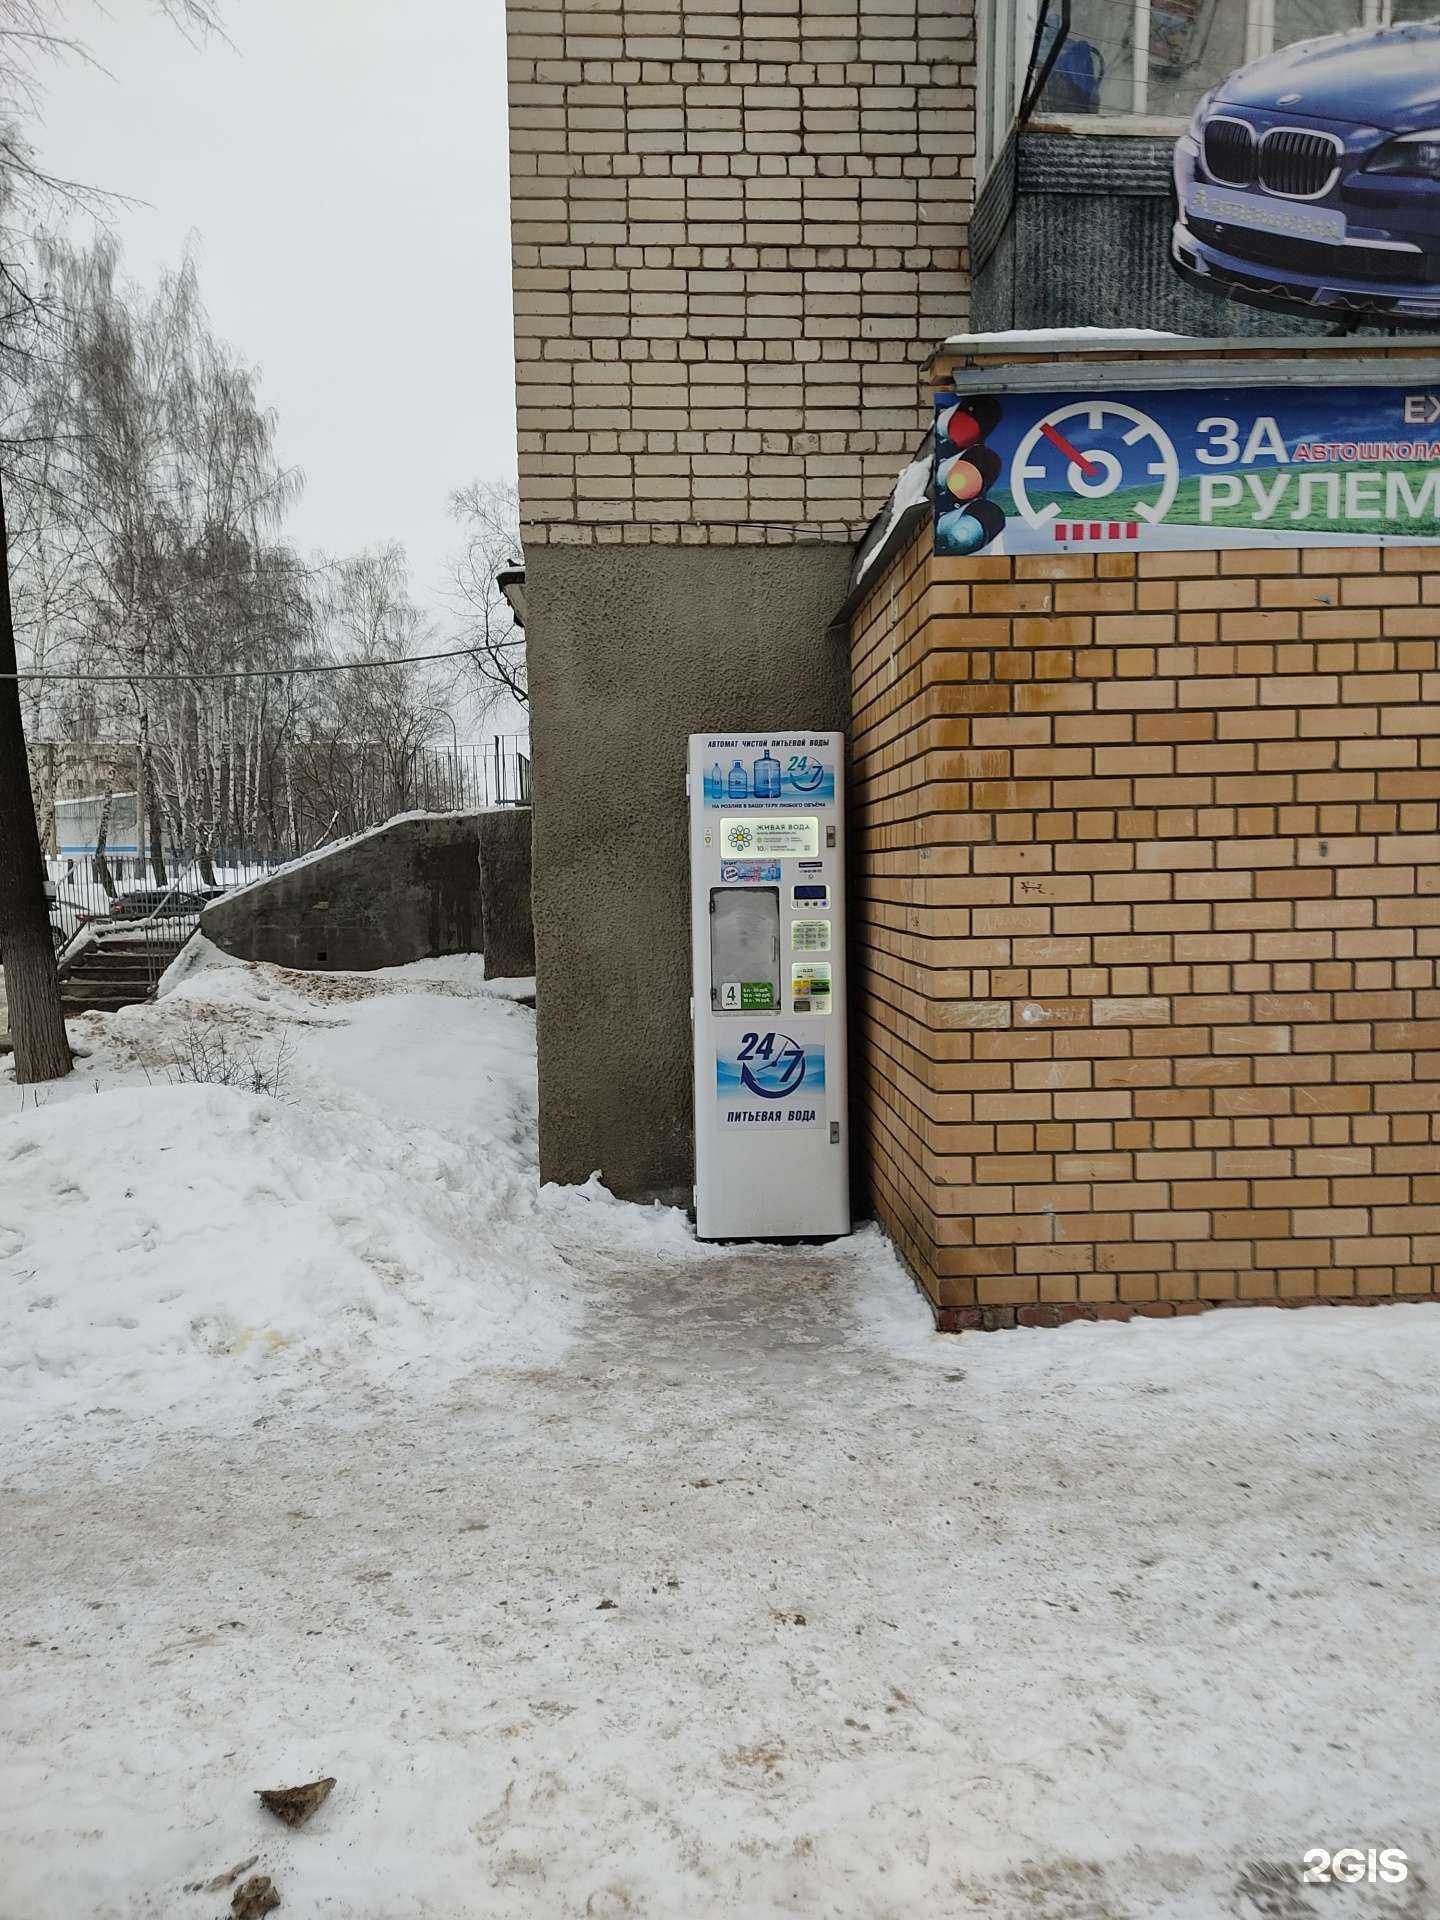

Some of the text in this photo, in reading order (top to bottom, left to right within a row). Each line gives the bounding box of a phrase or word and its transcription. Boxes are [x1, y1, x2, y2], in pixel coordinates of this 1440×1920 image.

[1195, 417, 1290, 465] ЗА
[1291, 440, 1440, 463] АВТОШКОЛА
[1200, 470, 1440, 522] РУЛЕМ
[708, 739, 830, 748] АВТОМАТ ЧИСТОЙ ПИТЬЕВОЙ ВОДЫ
[787, 756, 808, 771] 24
[727, 986, 736, 1001] 4
[737, 1033, 776, 1060] 24
[727, 1110, 816, 1122] ПИТЬЕВАЯ ВОДА
